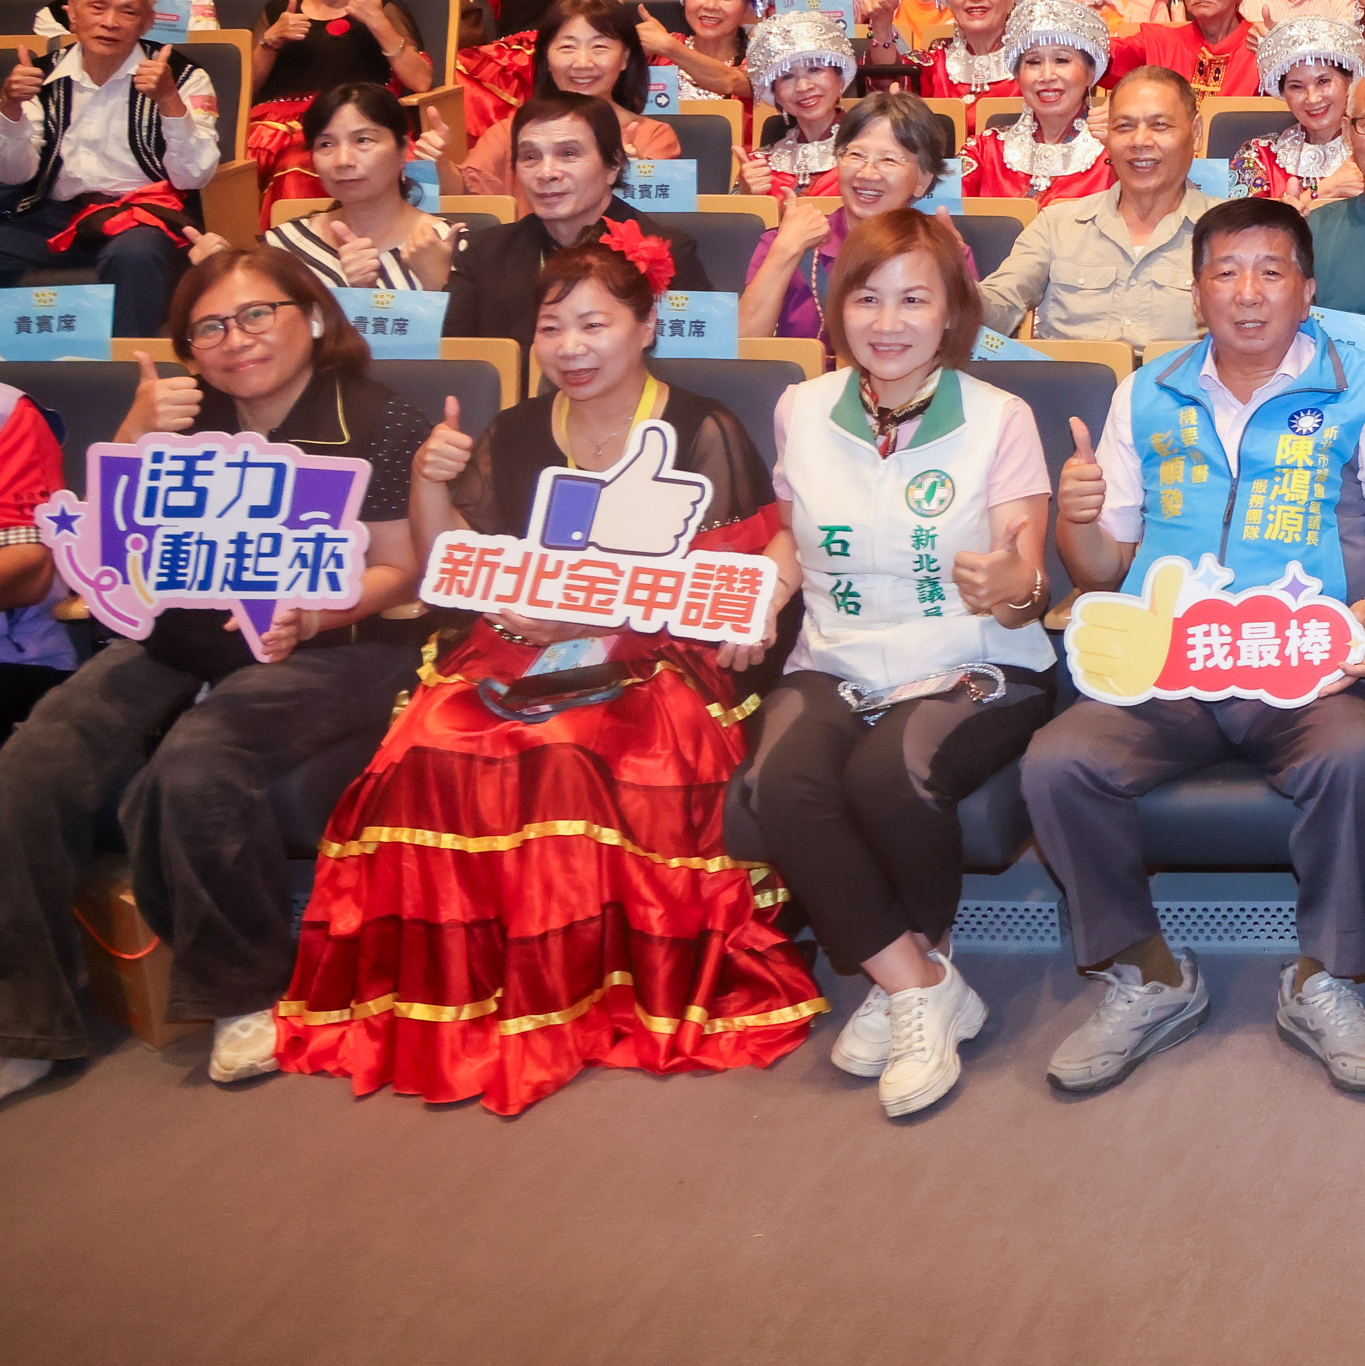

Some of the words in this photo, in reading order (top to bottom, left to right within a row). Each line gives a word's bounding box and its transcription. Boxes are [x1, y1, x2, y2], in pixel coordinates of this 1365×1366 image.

[622, 183, 670, 200] 貴賓席
[15, 314, 77, 334] 貴賓席
[143, 450, 288, 521] 活力
[1242, 479, 1268, 541] 服務團隊
[1264, 434, 1315, 544] 陳鴻源
[152, 530, 349, 594] 動起來
[432, 541, 764, 635] 新北金甲讚
[1185, 618, 1332, 670] 我最棒
